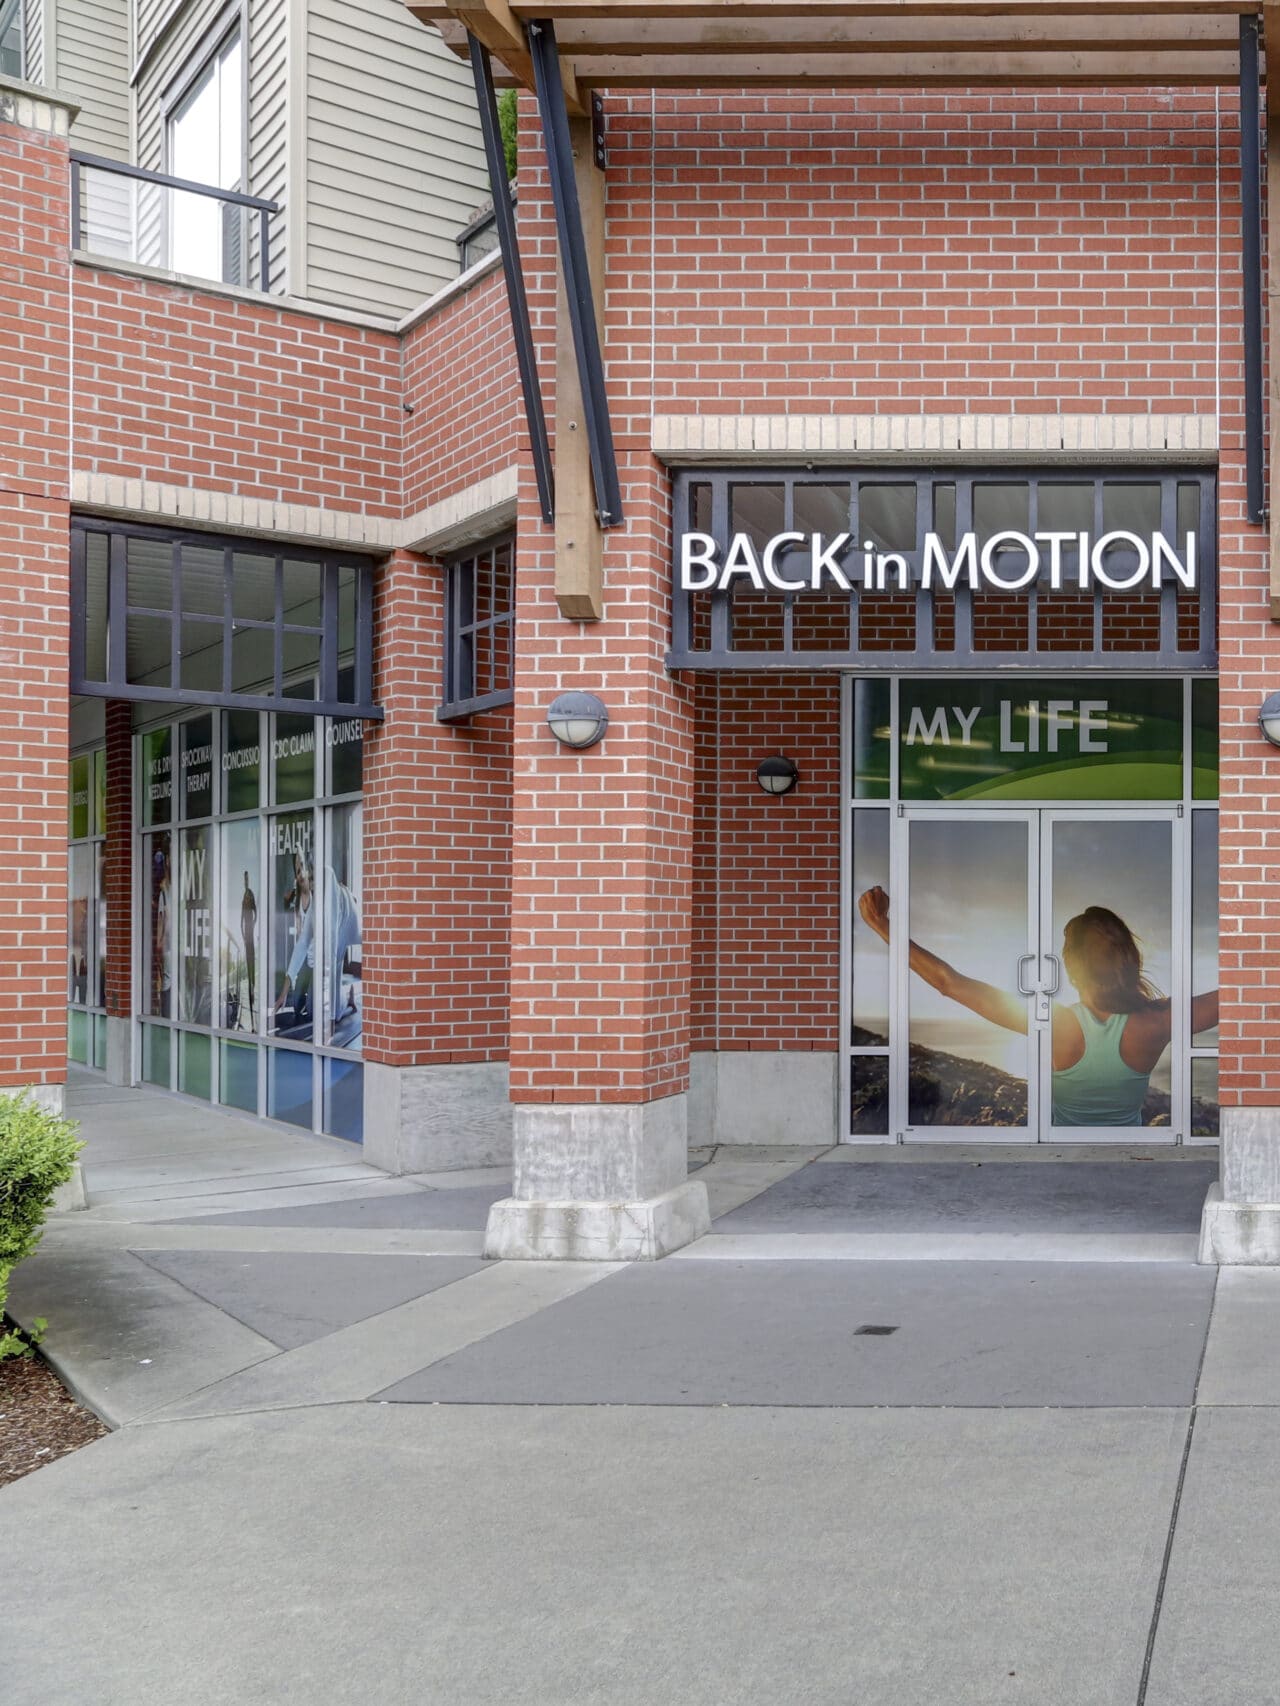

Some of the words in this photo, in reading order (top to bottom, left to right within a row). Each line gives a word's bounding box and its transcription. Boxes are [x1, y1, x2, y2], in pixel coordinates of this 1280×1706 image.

[680, 531, 852, 591] BACK
[863, 540, 906, 591] in
[921, 530, 1196, 590] MOTION
[906, 707, 981, 745] MY
[1001, 700, 1109, 753] LIFE
[187, 772, 210, 792] THERAPY
[269, 820, 310, 857] HEALTH
[181, 849, 205, 900] MY
[184, 909, 210, 957] LIFE
